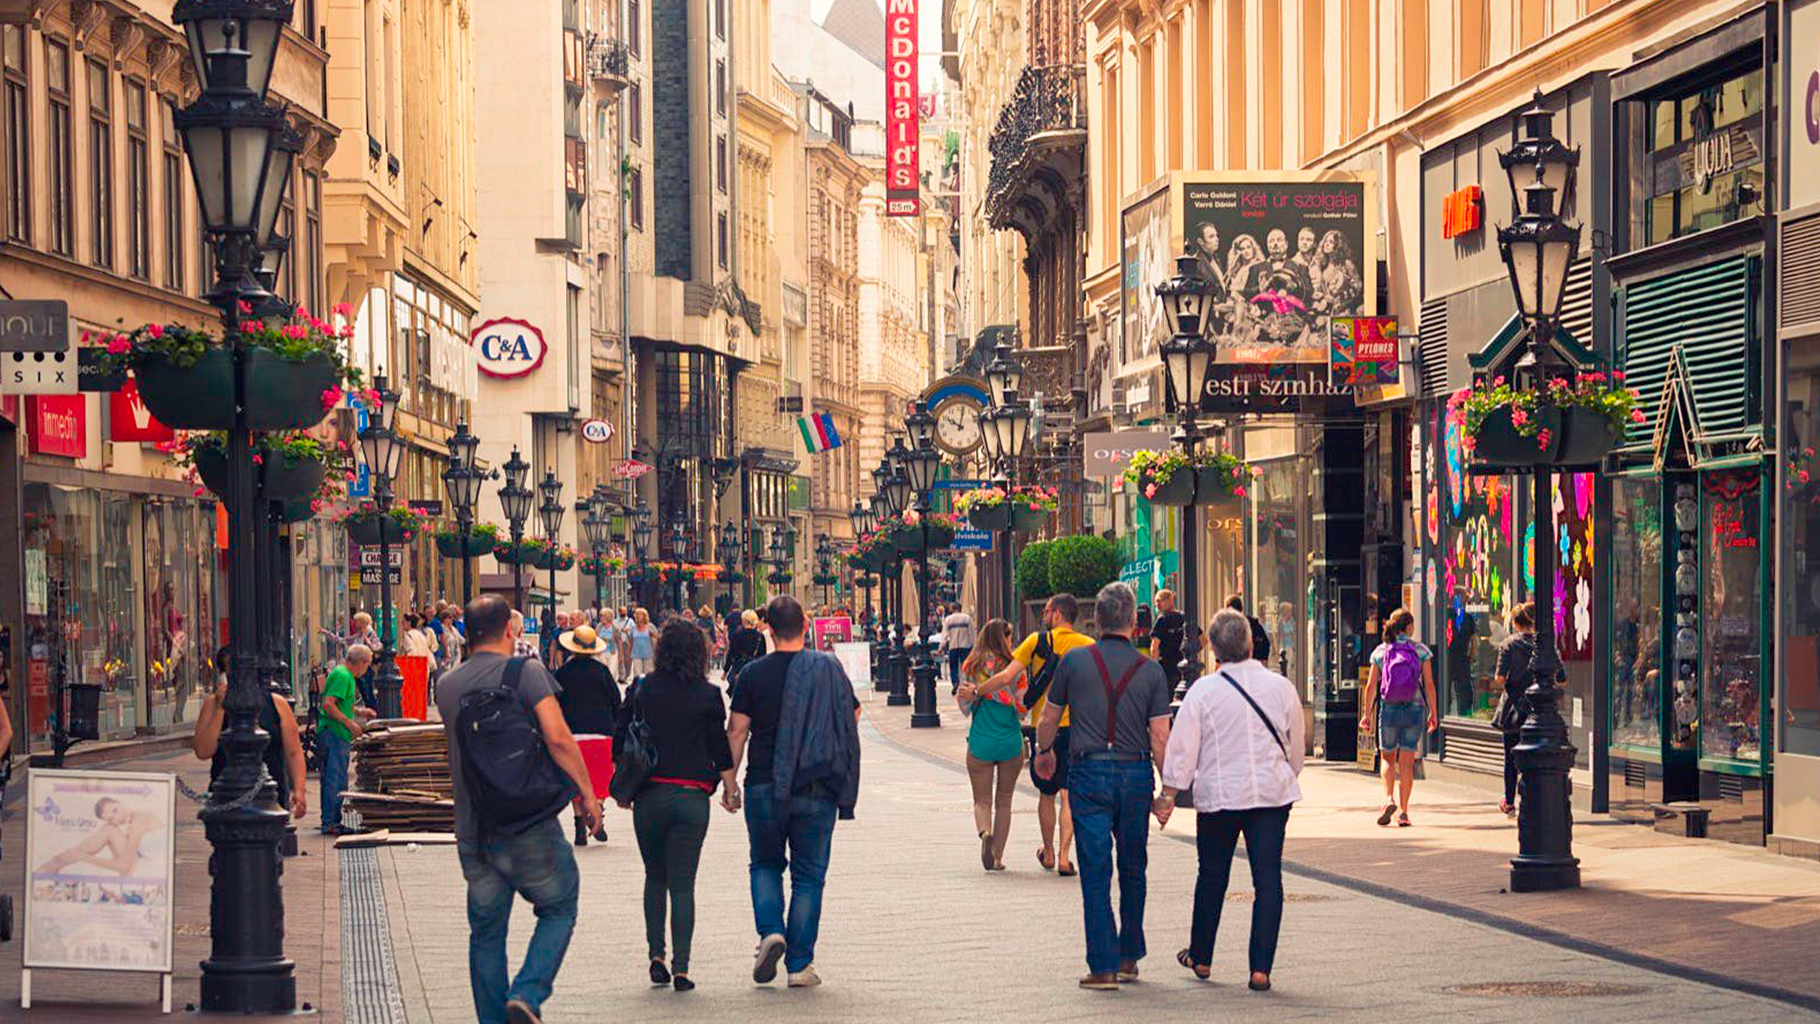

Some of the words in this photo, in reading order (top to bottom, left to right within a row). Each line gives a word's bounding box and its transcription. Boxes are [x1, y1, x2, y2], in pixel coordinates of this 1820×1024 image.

[890, 0, 916, 186] McDonald's
[481, 334, 533, 361] C&A
[1358, 342, 1394, 354] PYLONES
[14, 371, 64, 383] SIX
[586, 424, 606, 437] C&A
[366, 553, 398, 563] CHAGE
[363, 573, 399, 583] MASGE
